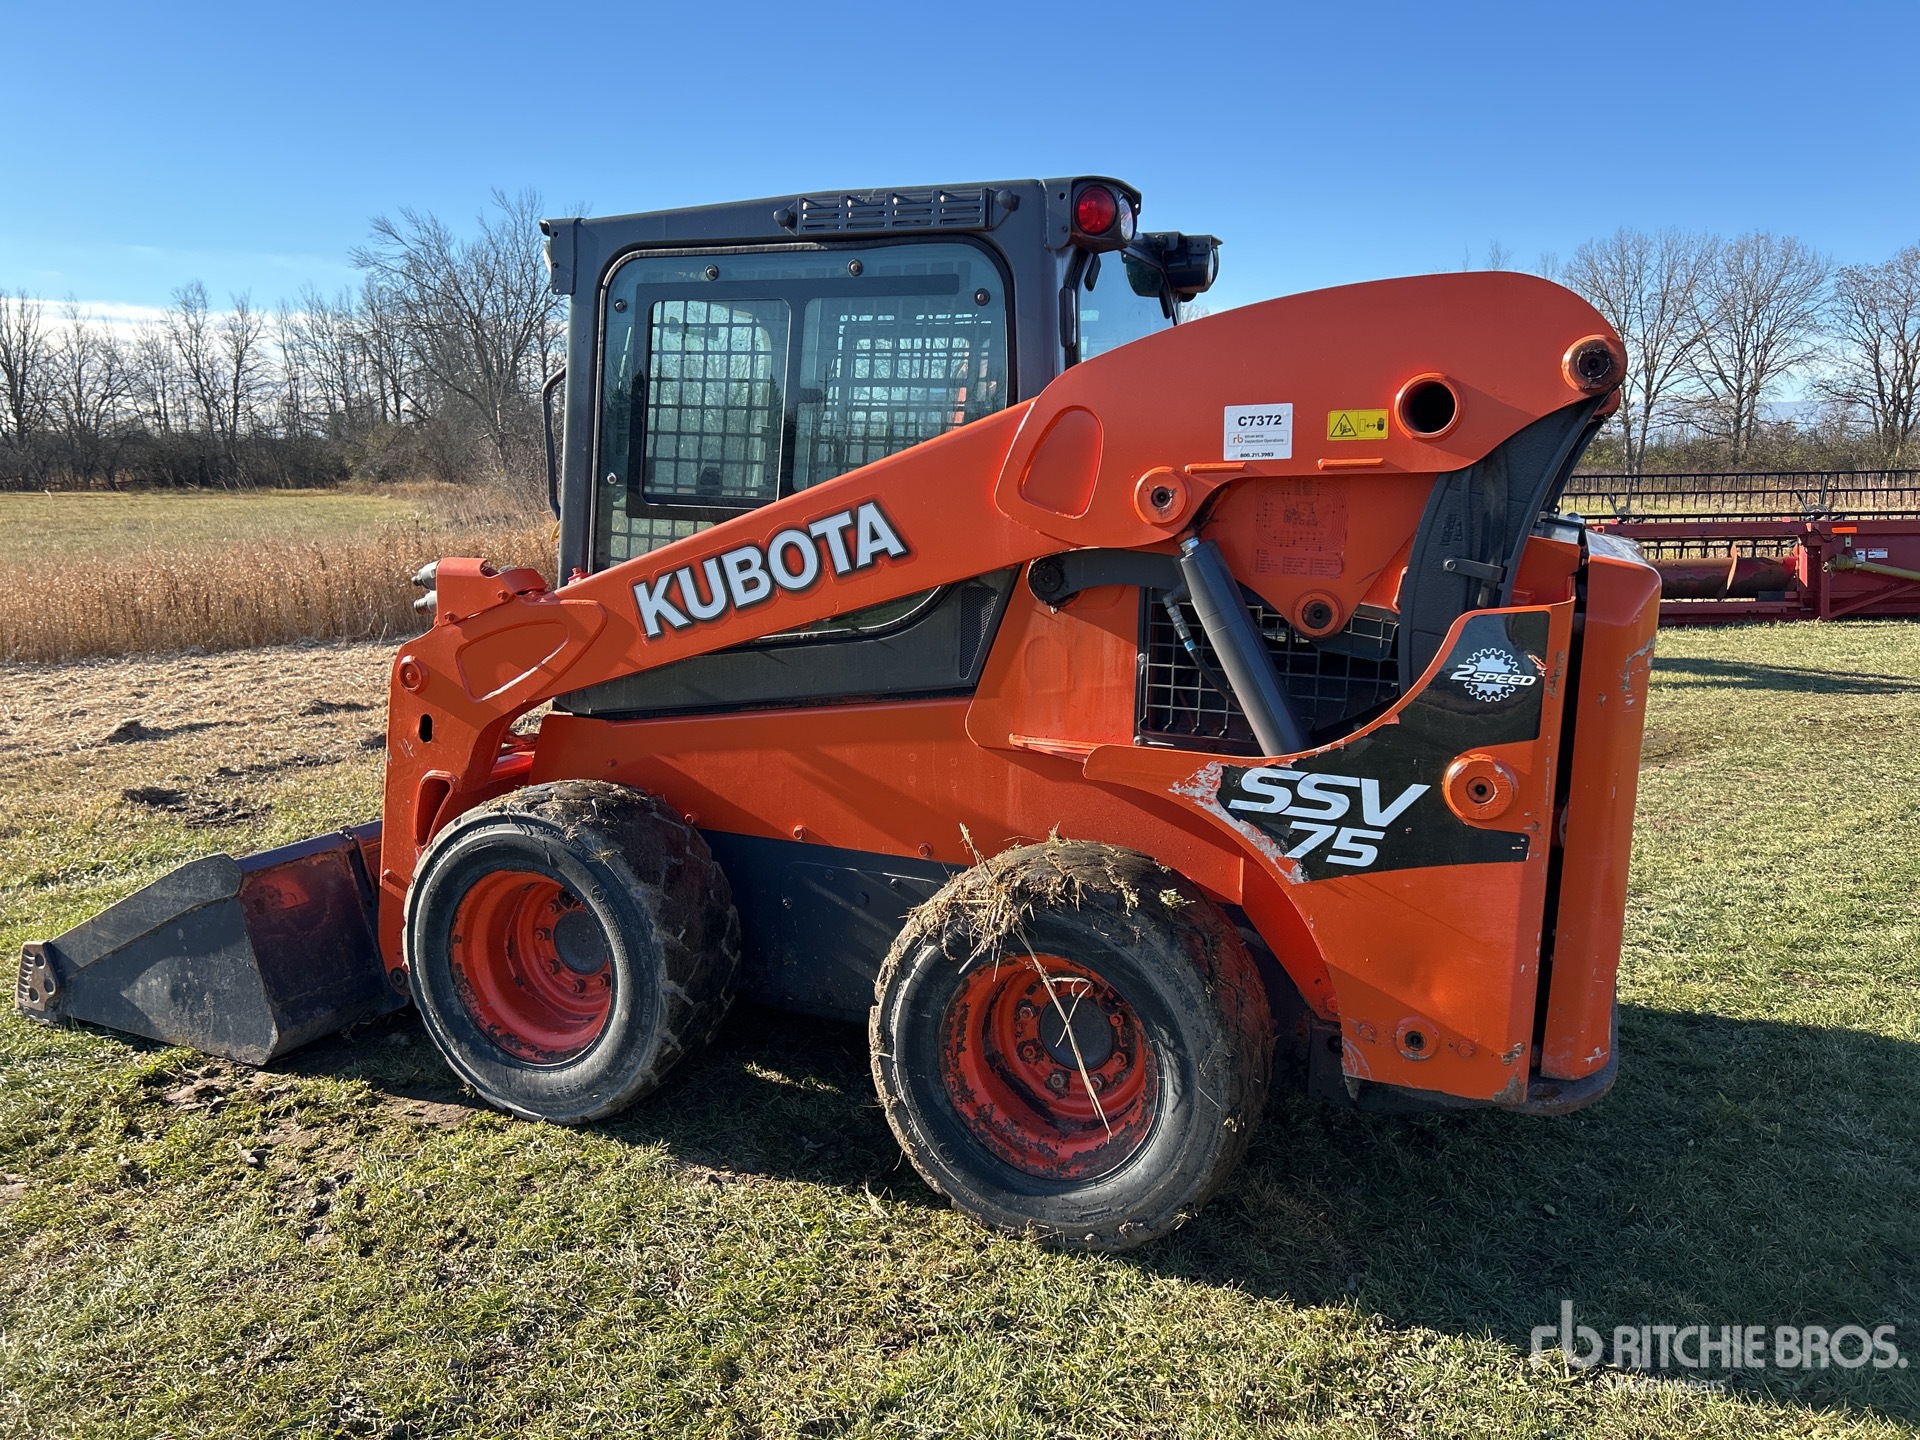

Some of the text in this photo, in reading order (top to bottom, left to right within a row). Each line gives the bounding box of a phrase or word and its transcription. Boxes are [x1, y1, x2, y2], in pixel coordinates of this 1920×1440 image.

[1237, 414, 1282, 427] C7372
[633, 501, 908, 638] KUBOTA
[1228, 767, 1431, 827] SSV
[1285, 820, 1385, 867] 75
